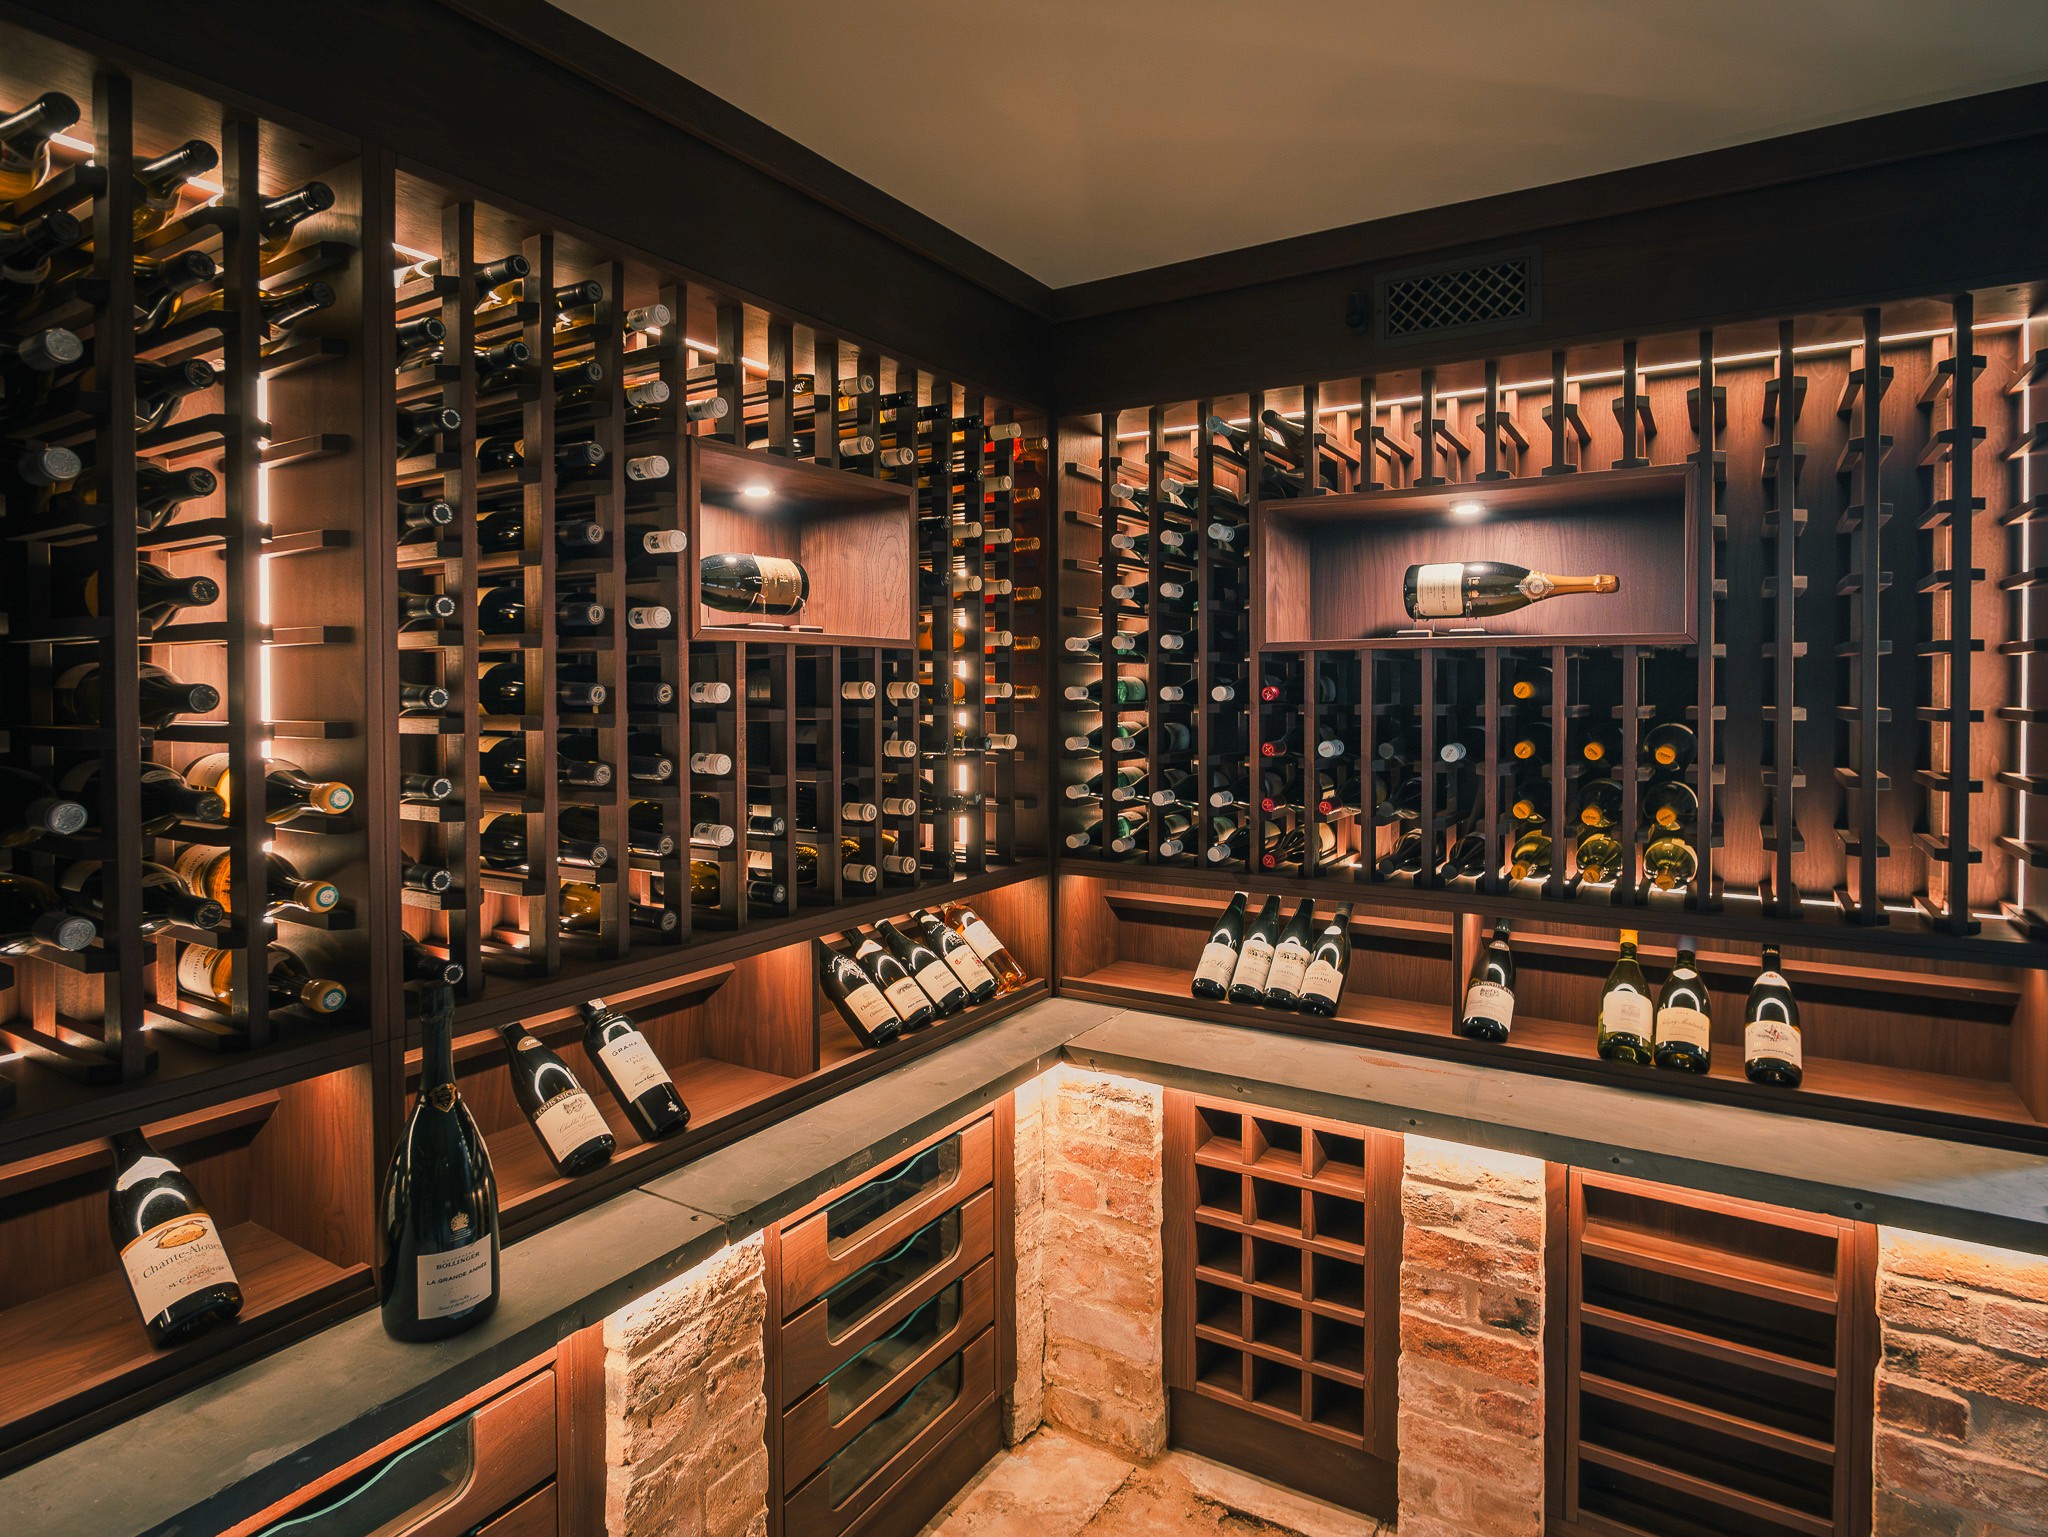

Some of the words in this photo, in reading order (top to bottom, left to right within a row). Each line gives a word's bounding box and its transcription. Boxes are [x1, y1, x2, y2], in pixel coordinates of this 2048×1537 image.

[536, 1099, 556, 1117] LOUIS
[435, 1251, 481, 1270] BOLLINGER
[437, 1271, 468, 1284] GRANDE
